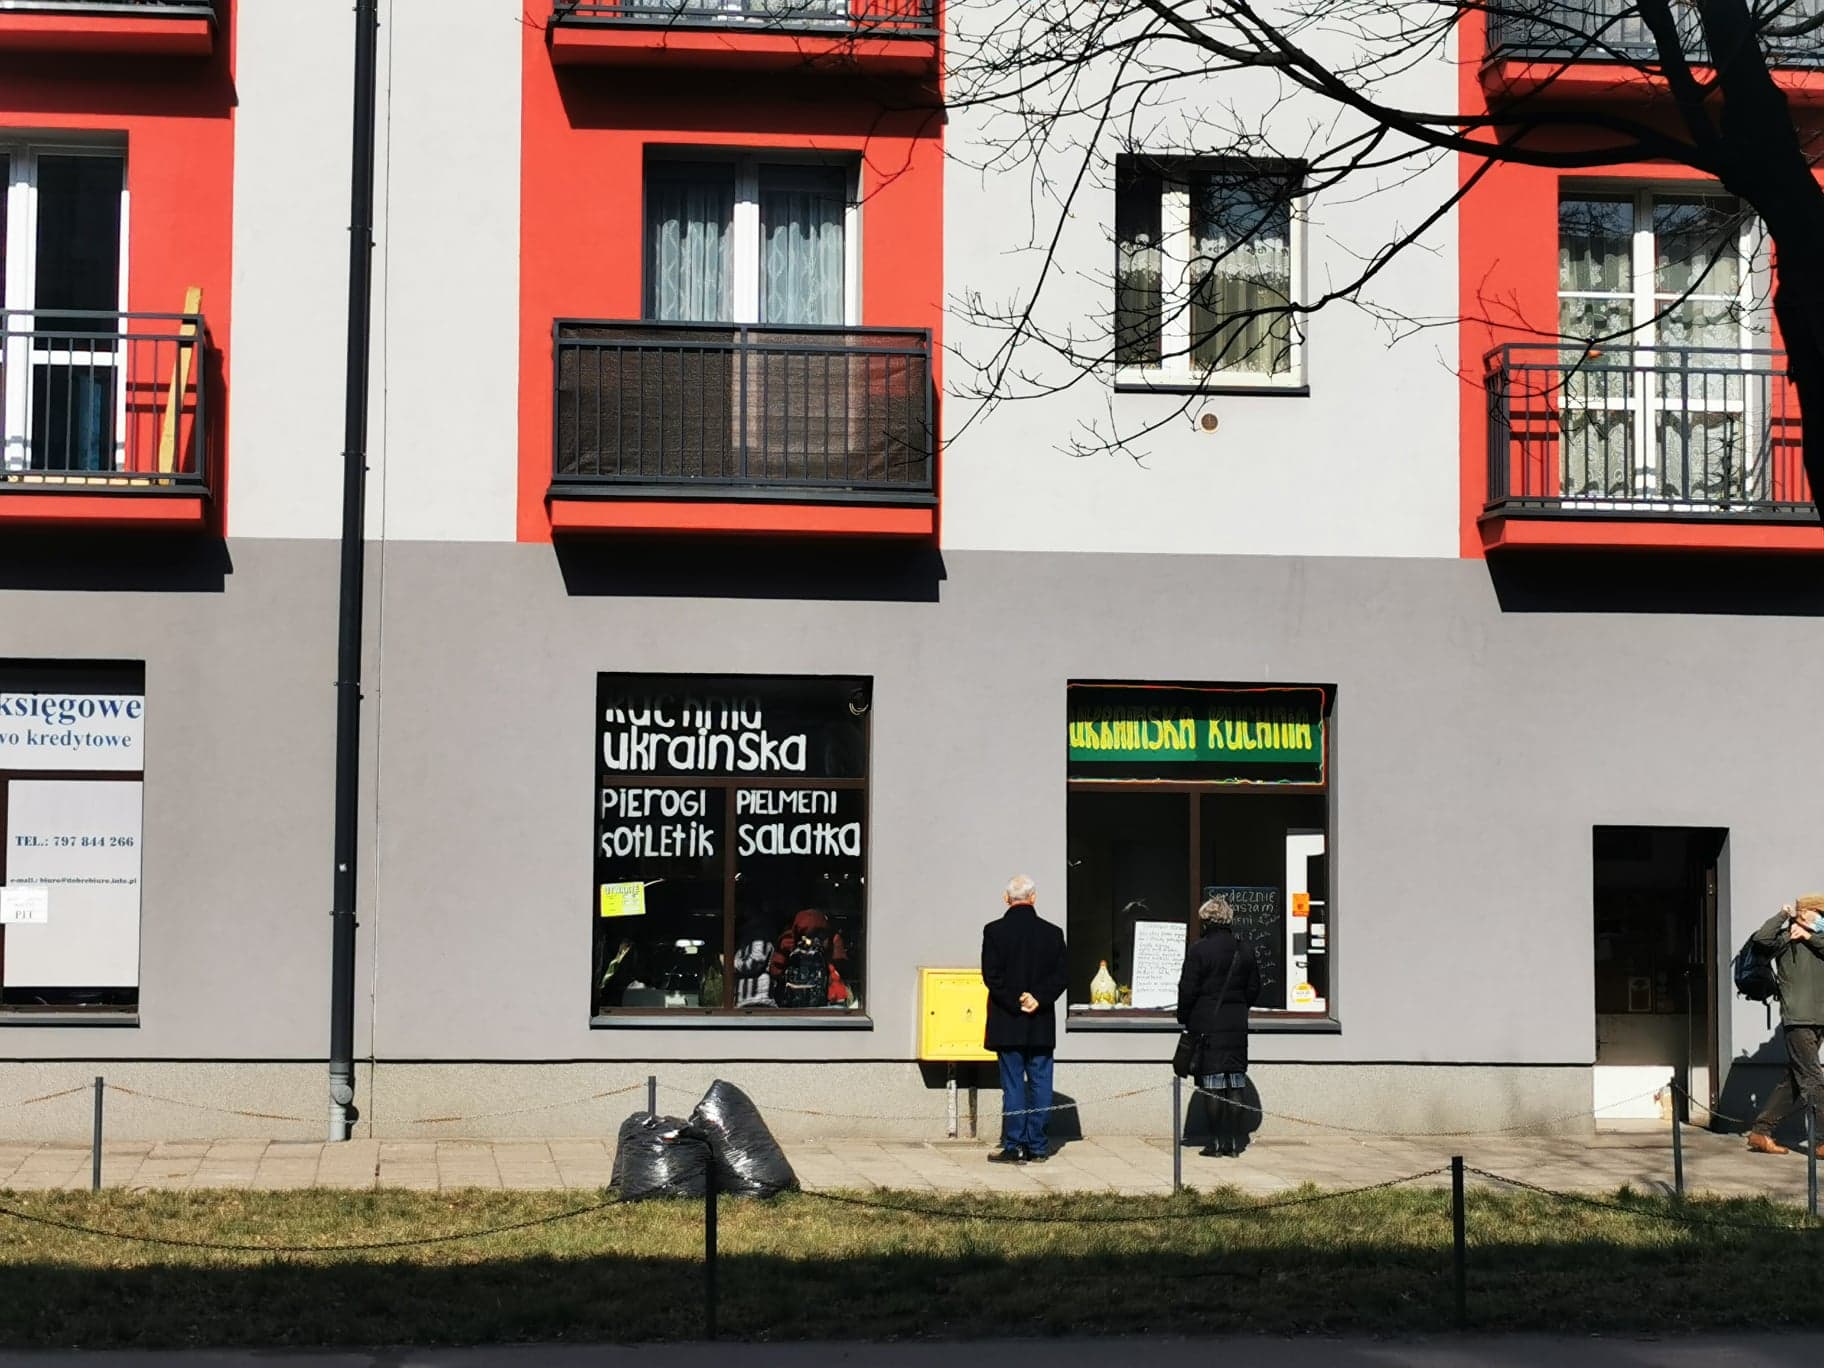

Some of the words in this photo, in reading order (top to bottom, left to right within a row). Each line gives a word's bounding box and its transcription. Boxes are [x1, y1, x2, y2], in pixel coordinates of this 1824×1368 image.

[27, 729, 132, 751] kredytowe
[603, 725, 807, 772] ukrainska
[53, 836, 77, 847] 797
[81, 836, 105, 847] 844
[109, 836, 134, 847] 266
